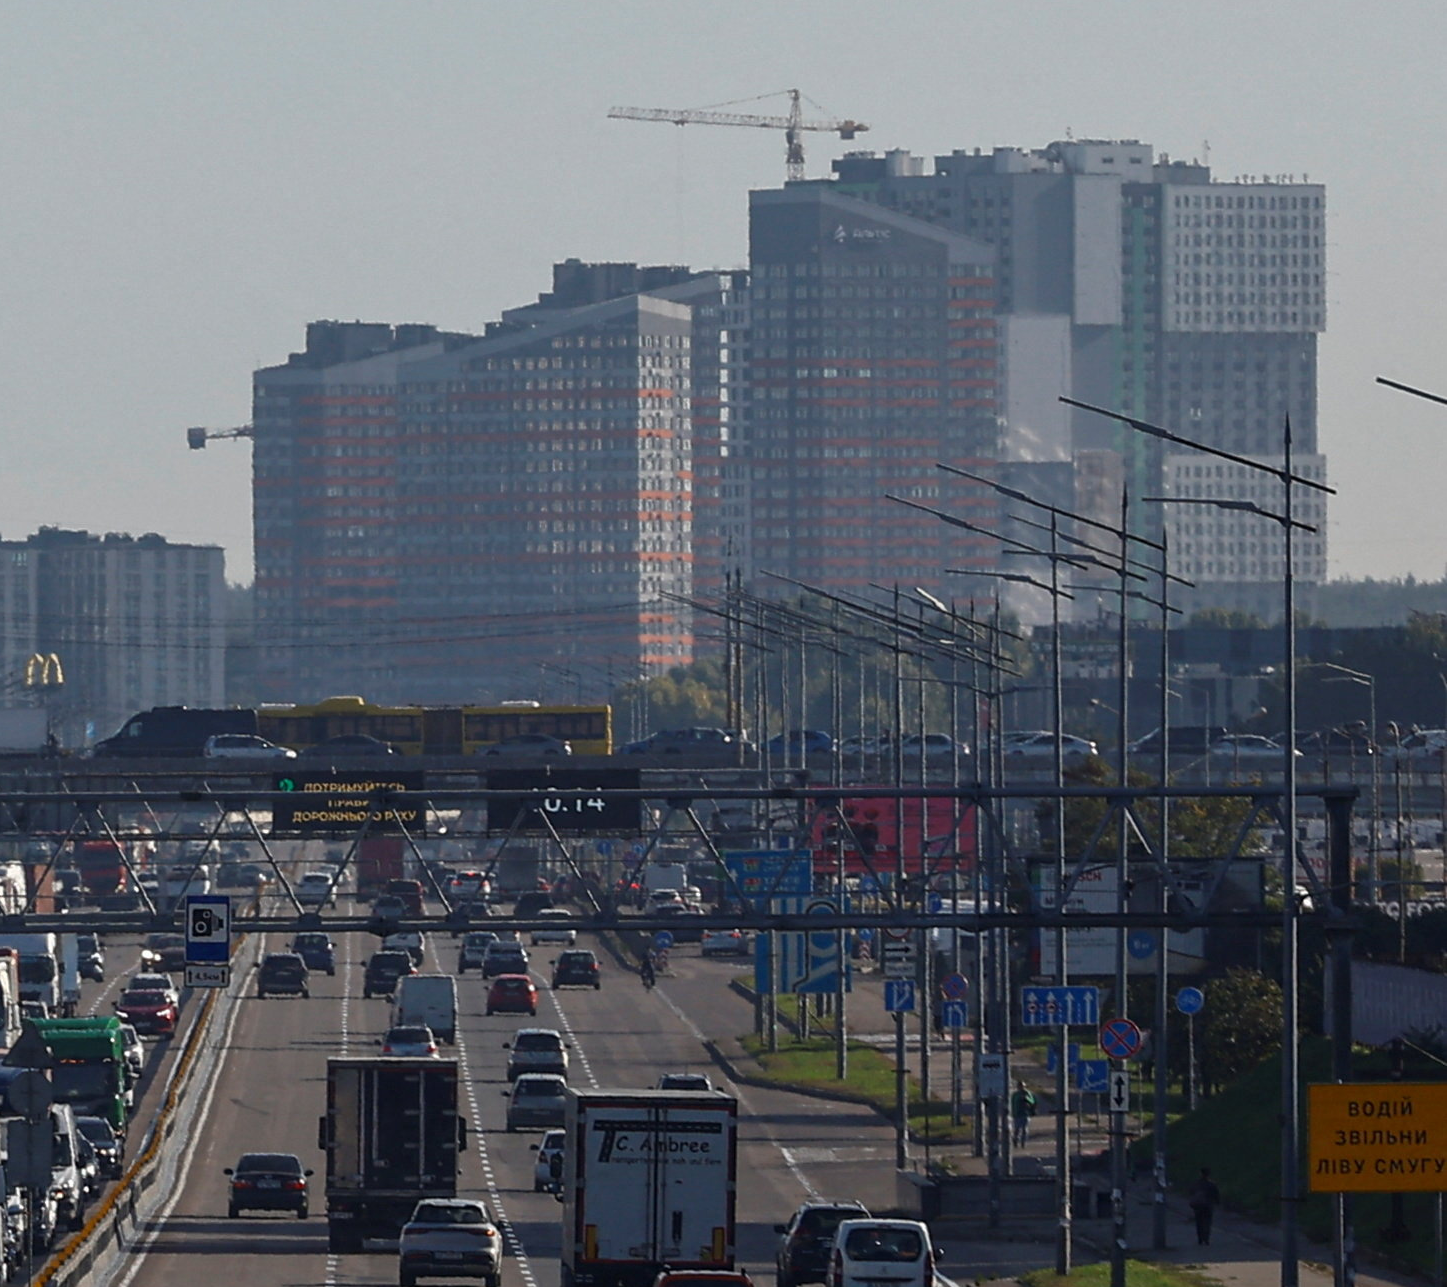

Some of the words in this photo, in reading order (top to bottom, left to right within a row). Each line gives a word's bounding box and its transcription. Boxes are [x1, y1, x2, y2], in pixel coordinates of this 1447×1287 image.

[1348, 1096, 1413, 1118] ВОДІЙ
[639, 1136, 711, 1155] Ambree
[1335, 1129, 1428, 1146] ЗВІЛЬНИ
[1316, 1158, 1366, 1174] ЛІВУ
[1374, 1158, 1446, 1174] СМУГУ
